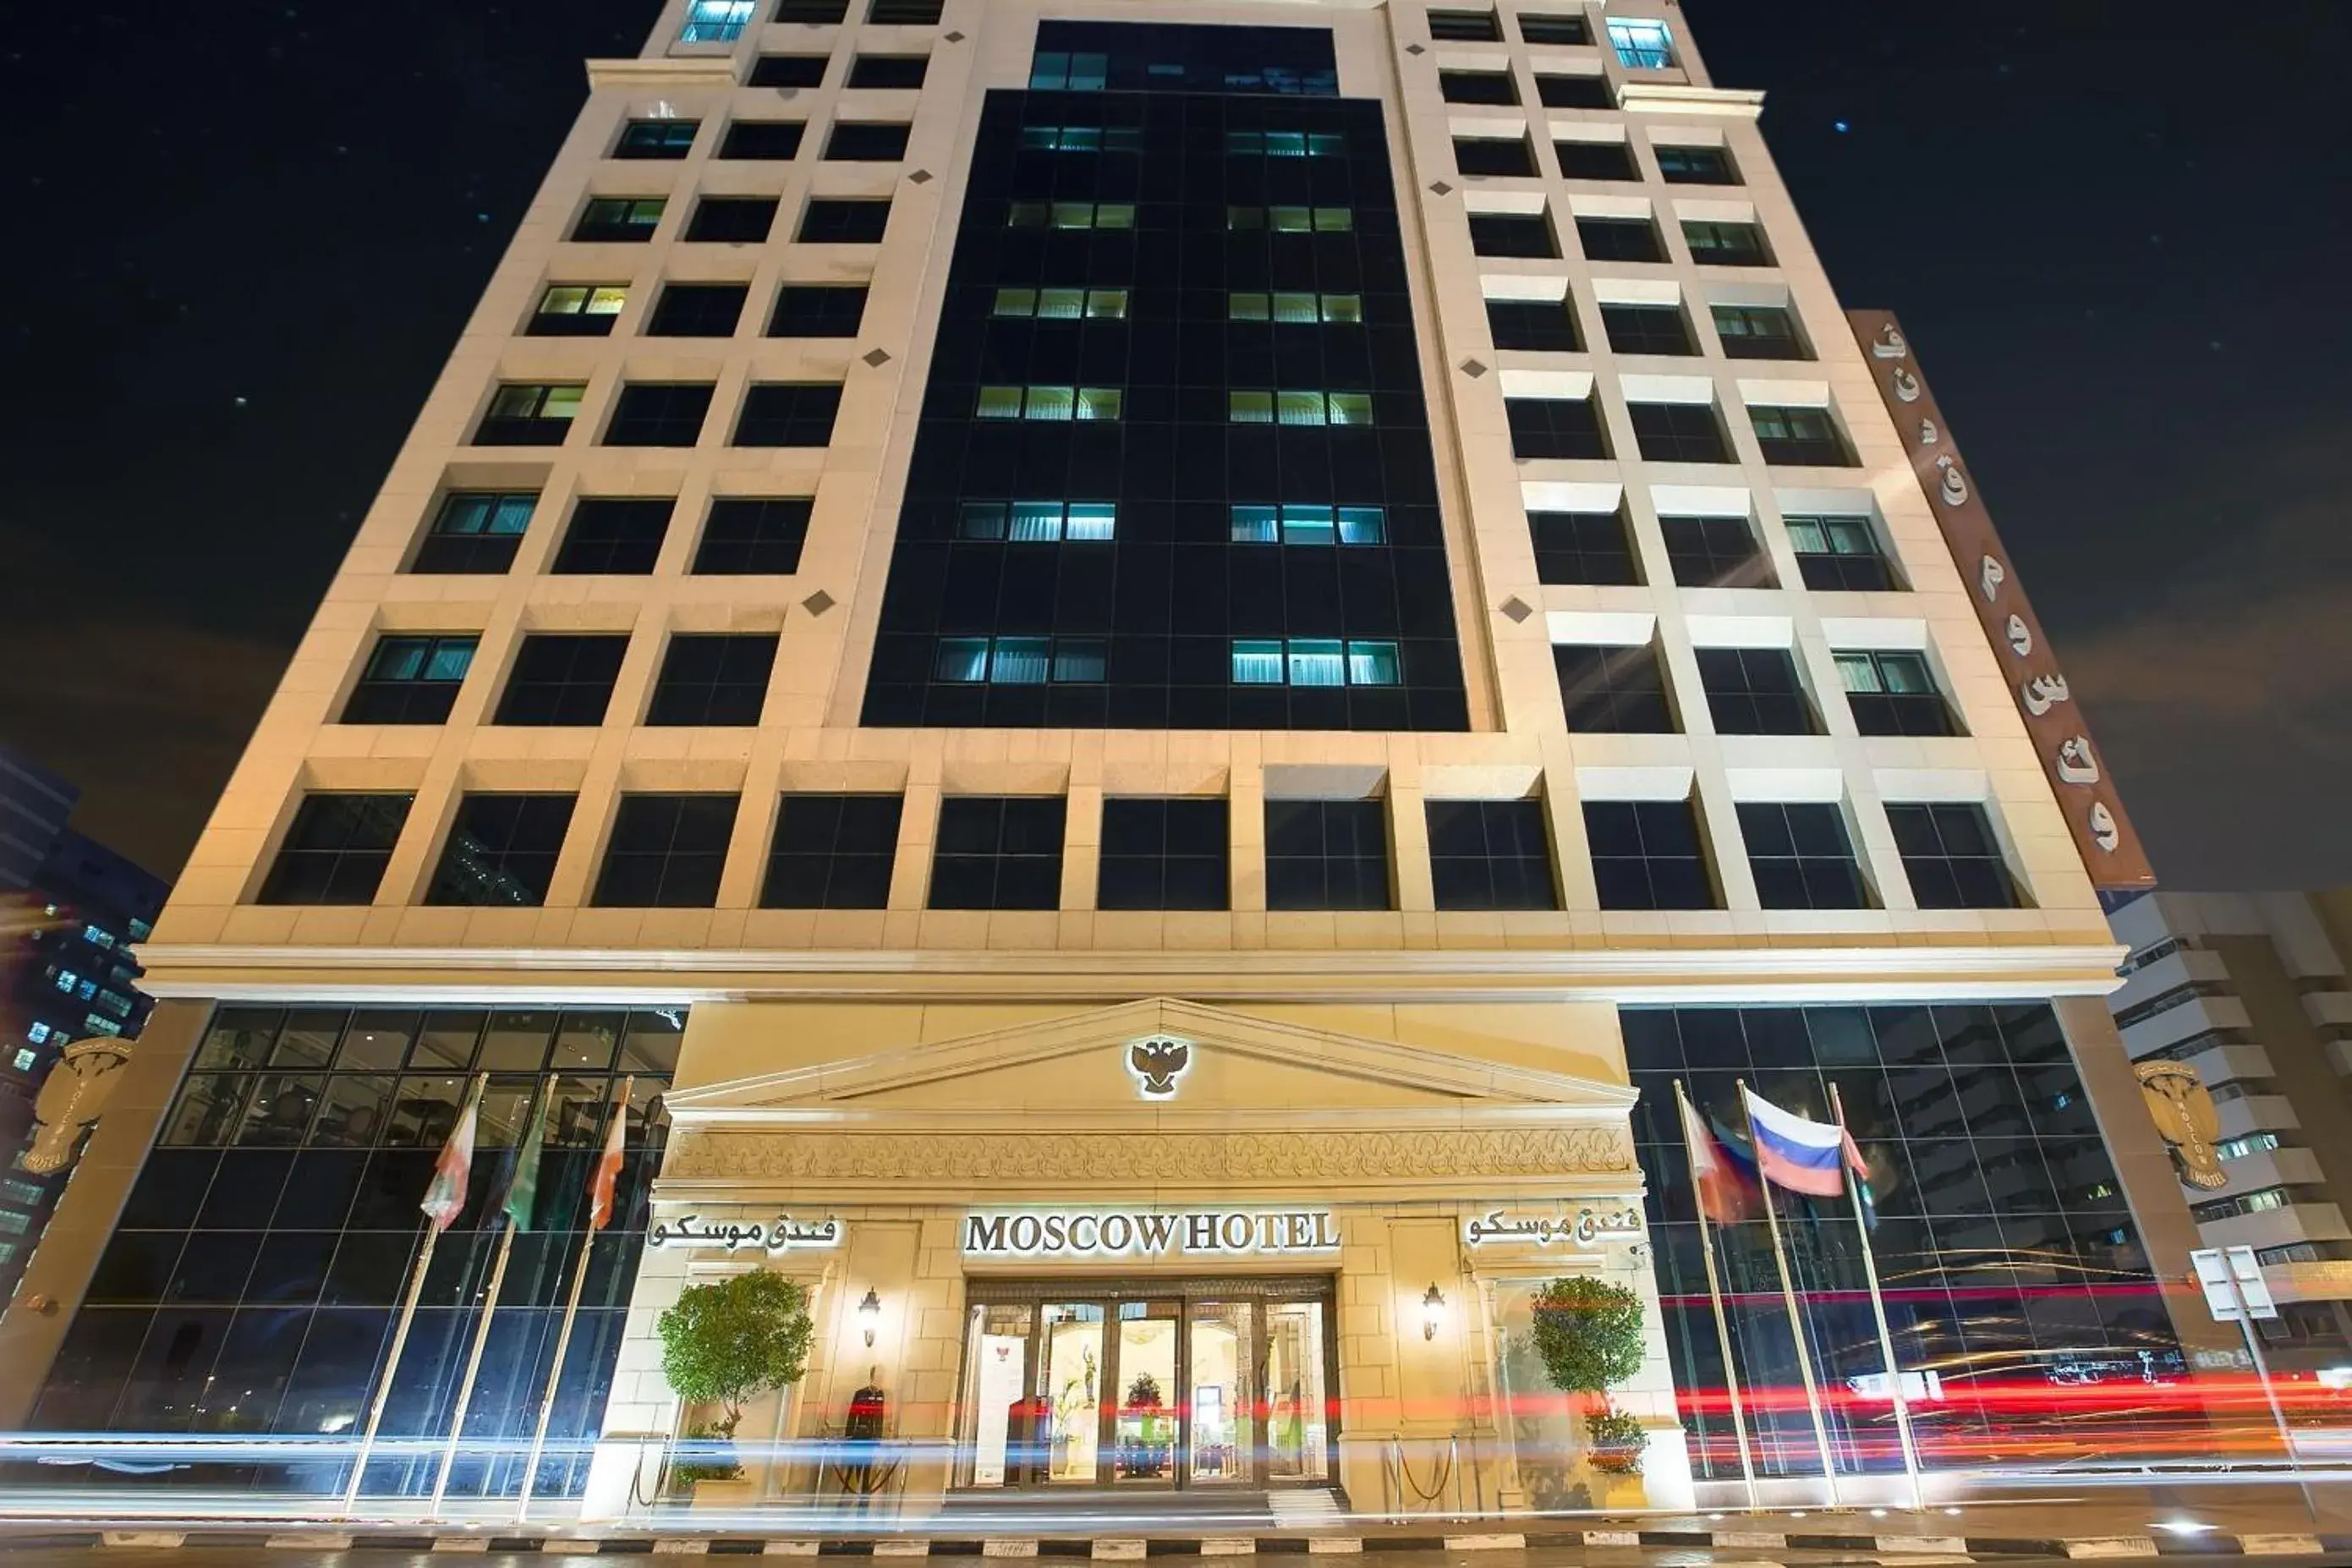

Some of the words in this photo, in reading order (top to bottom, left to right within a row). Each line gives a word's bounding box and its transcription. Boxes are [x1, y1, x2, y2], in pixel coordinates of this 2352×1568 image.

[648, 1214, 763, 1249] موسكو
[767, 1214, 836, 1249] فندق
[965, 1214, 1178, 1252] MOSCOW
[1184, 1212, 1342, 1251] HOTEL
[1469, 1210, 1572, 1242] موسكو
[1578, 1208, 1642, 1242] فندق
